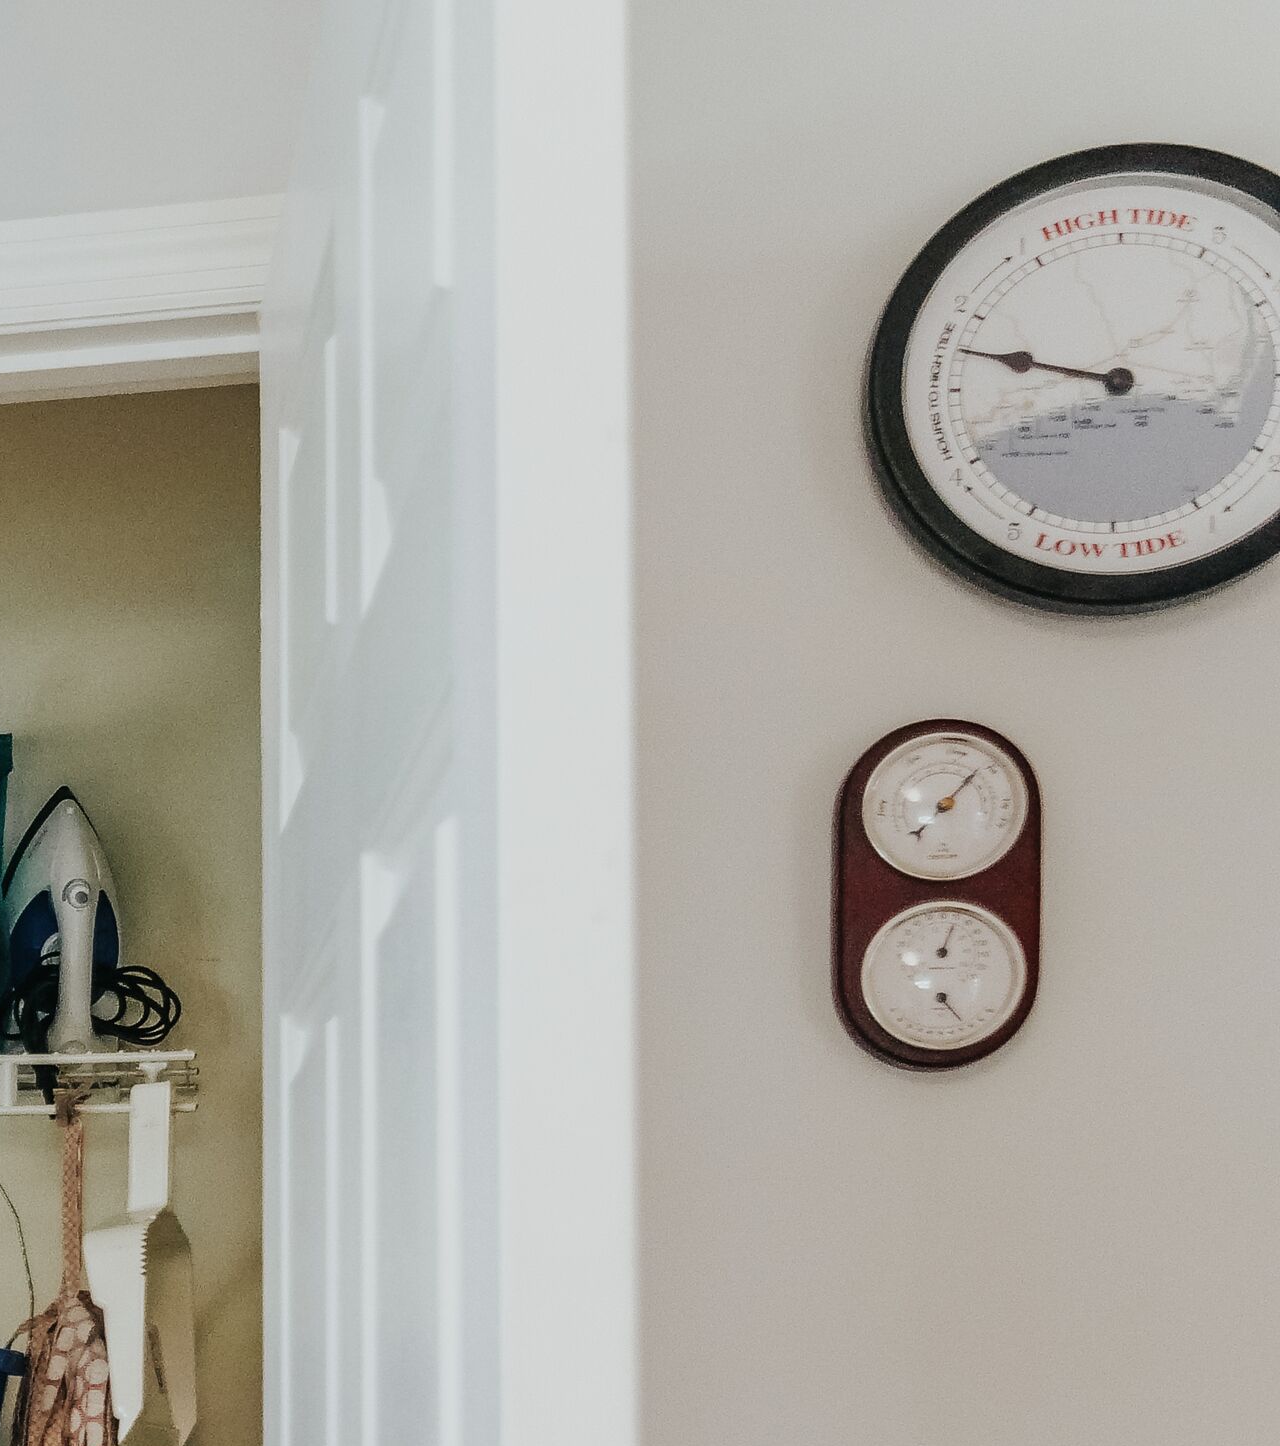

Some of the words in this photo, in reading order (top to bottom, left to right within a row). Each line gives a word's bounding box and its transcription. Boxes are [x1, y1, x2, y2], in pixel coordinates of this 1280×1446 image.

[1041, 208, 1119, 242] HIGH
[1128, 207, 1198, 233] TIDE
[1034, 531, 1109, 558] LOW
[1117, 528, 1188, 558] TIDE
